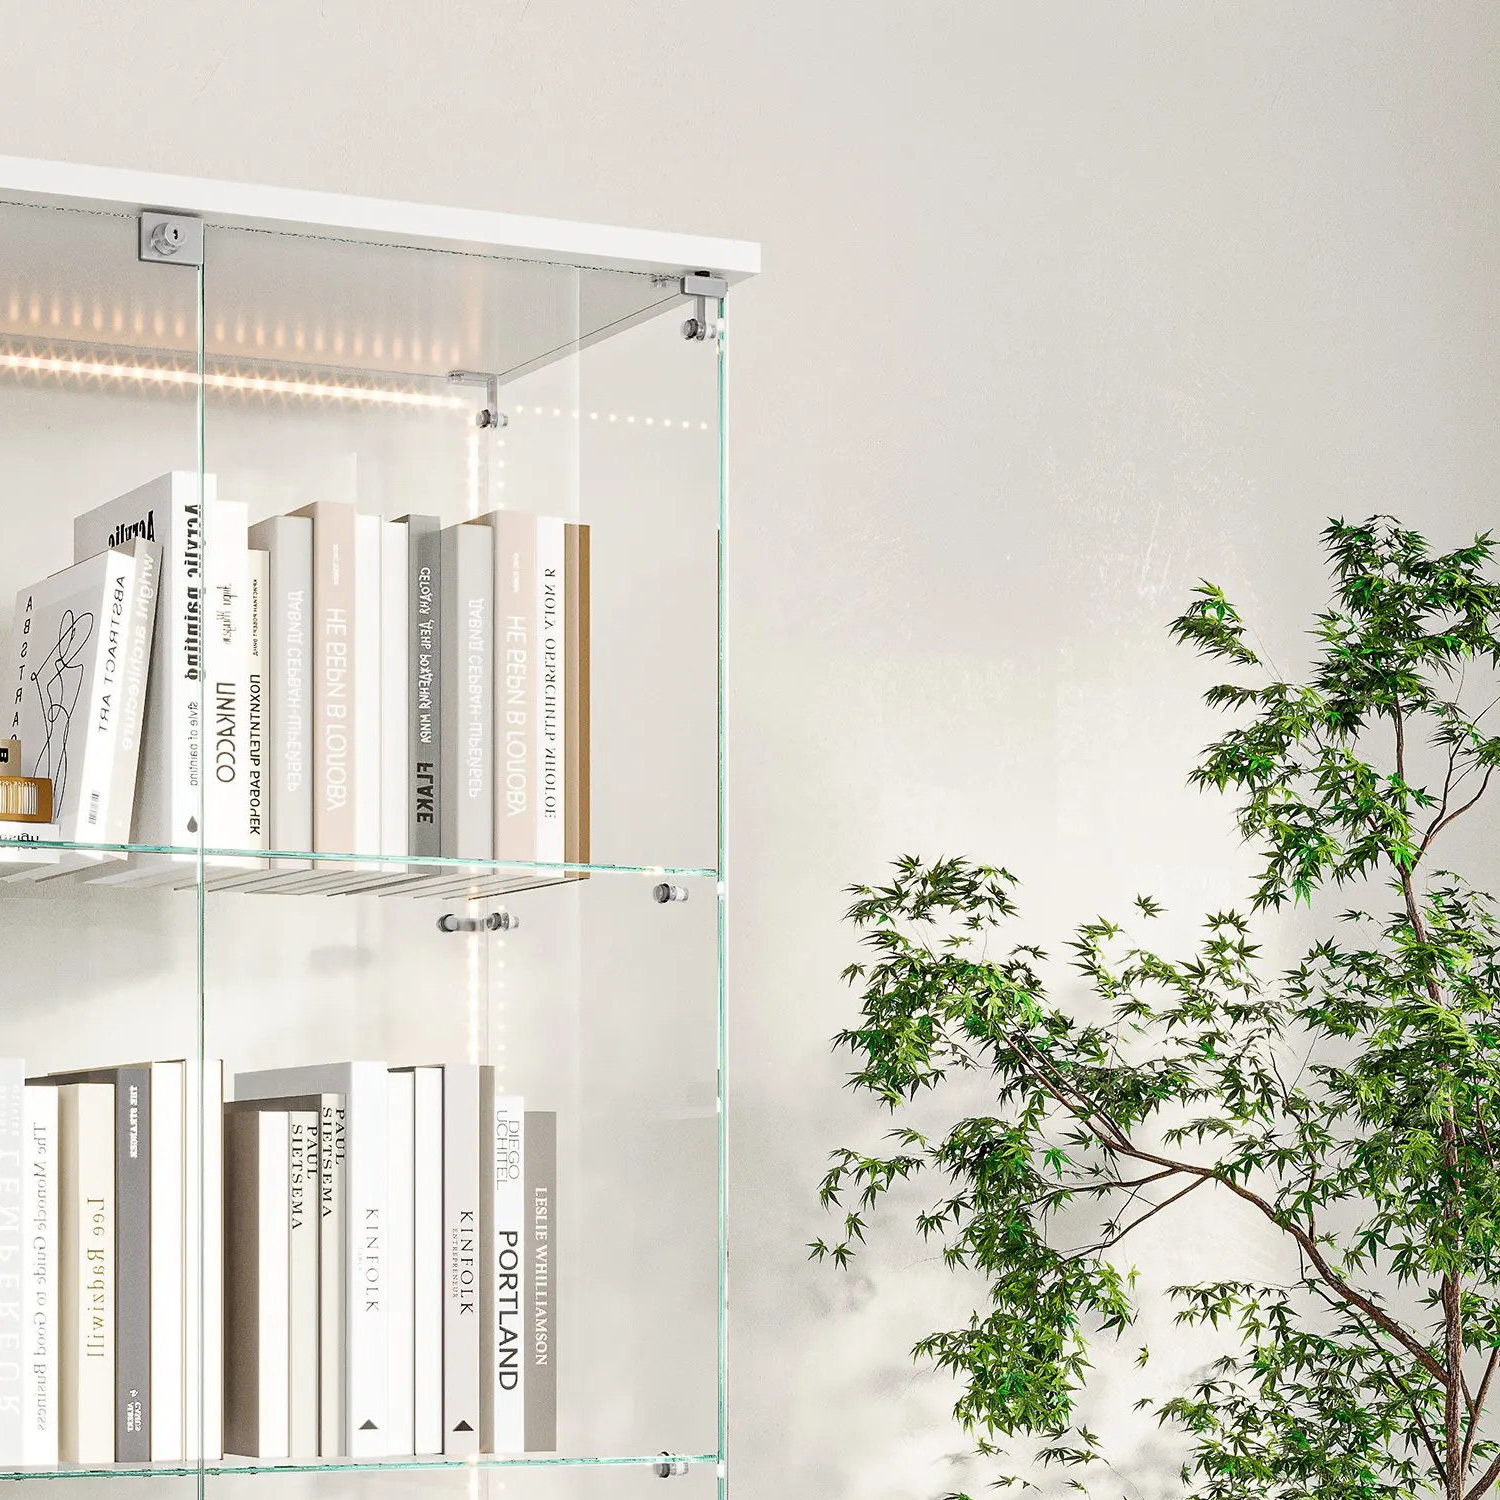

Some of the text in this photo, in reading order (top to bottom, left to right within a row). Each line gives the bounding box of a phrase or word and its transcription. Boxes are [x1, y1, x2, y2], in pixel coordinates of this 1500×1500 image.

[291, 1124, 302, 1230] SIETSEMA
[306, 1126, 317, 1179] PAUL
[321, 1107, 332, 1218] SIETSEMA
[334, 1108, 345, 1165] PAUL
[495, 1110, 507, 1191] UCHITEL
[507, 1120, 519, 1180] DIEGO
[364, 1208, 379, 1313] KINFOLK
[460, 1211, 474, 1315] KINFOLK
[498, 1231, 518, 1391] PORTLAND
[534, 1187, 547, 1366] LESLIE WHILLIAMSON
